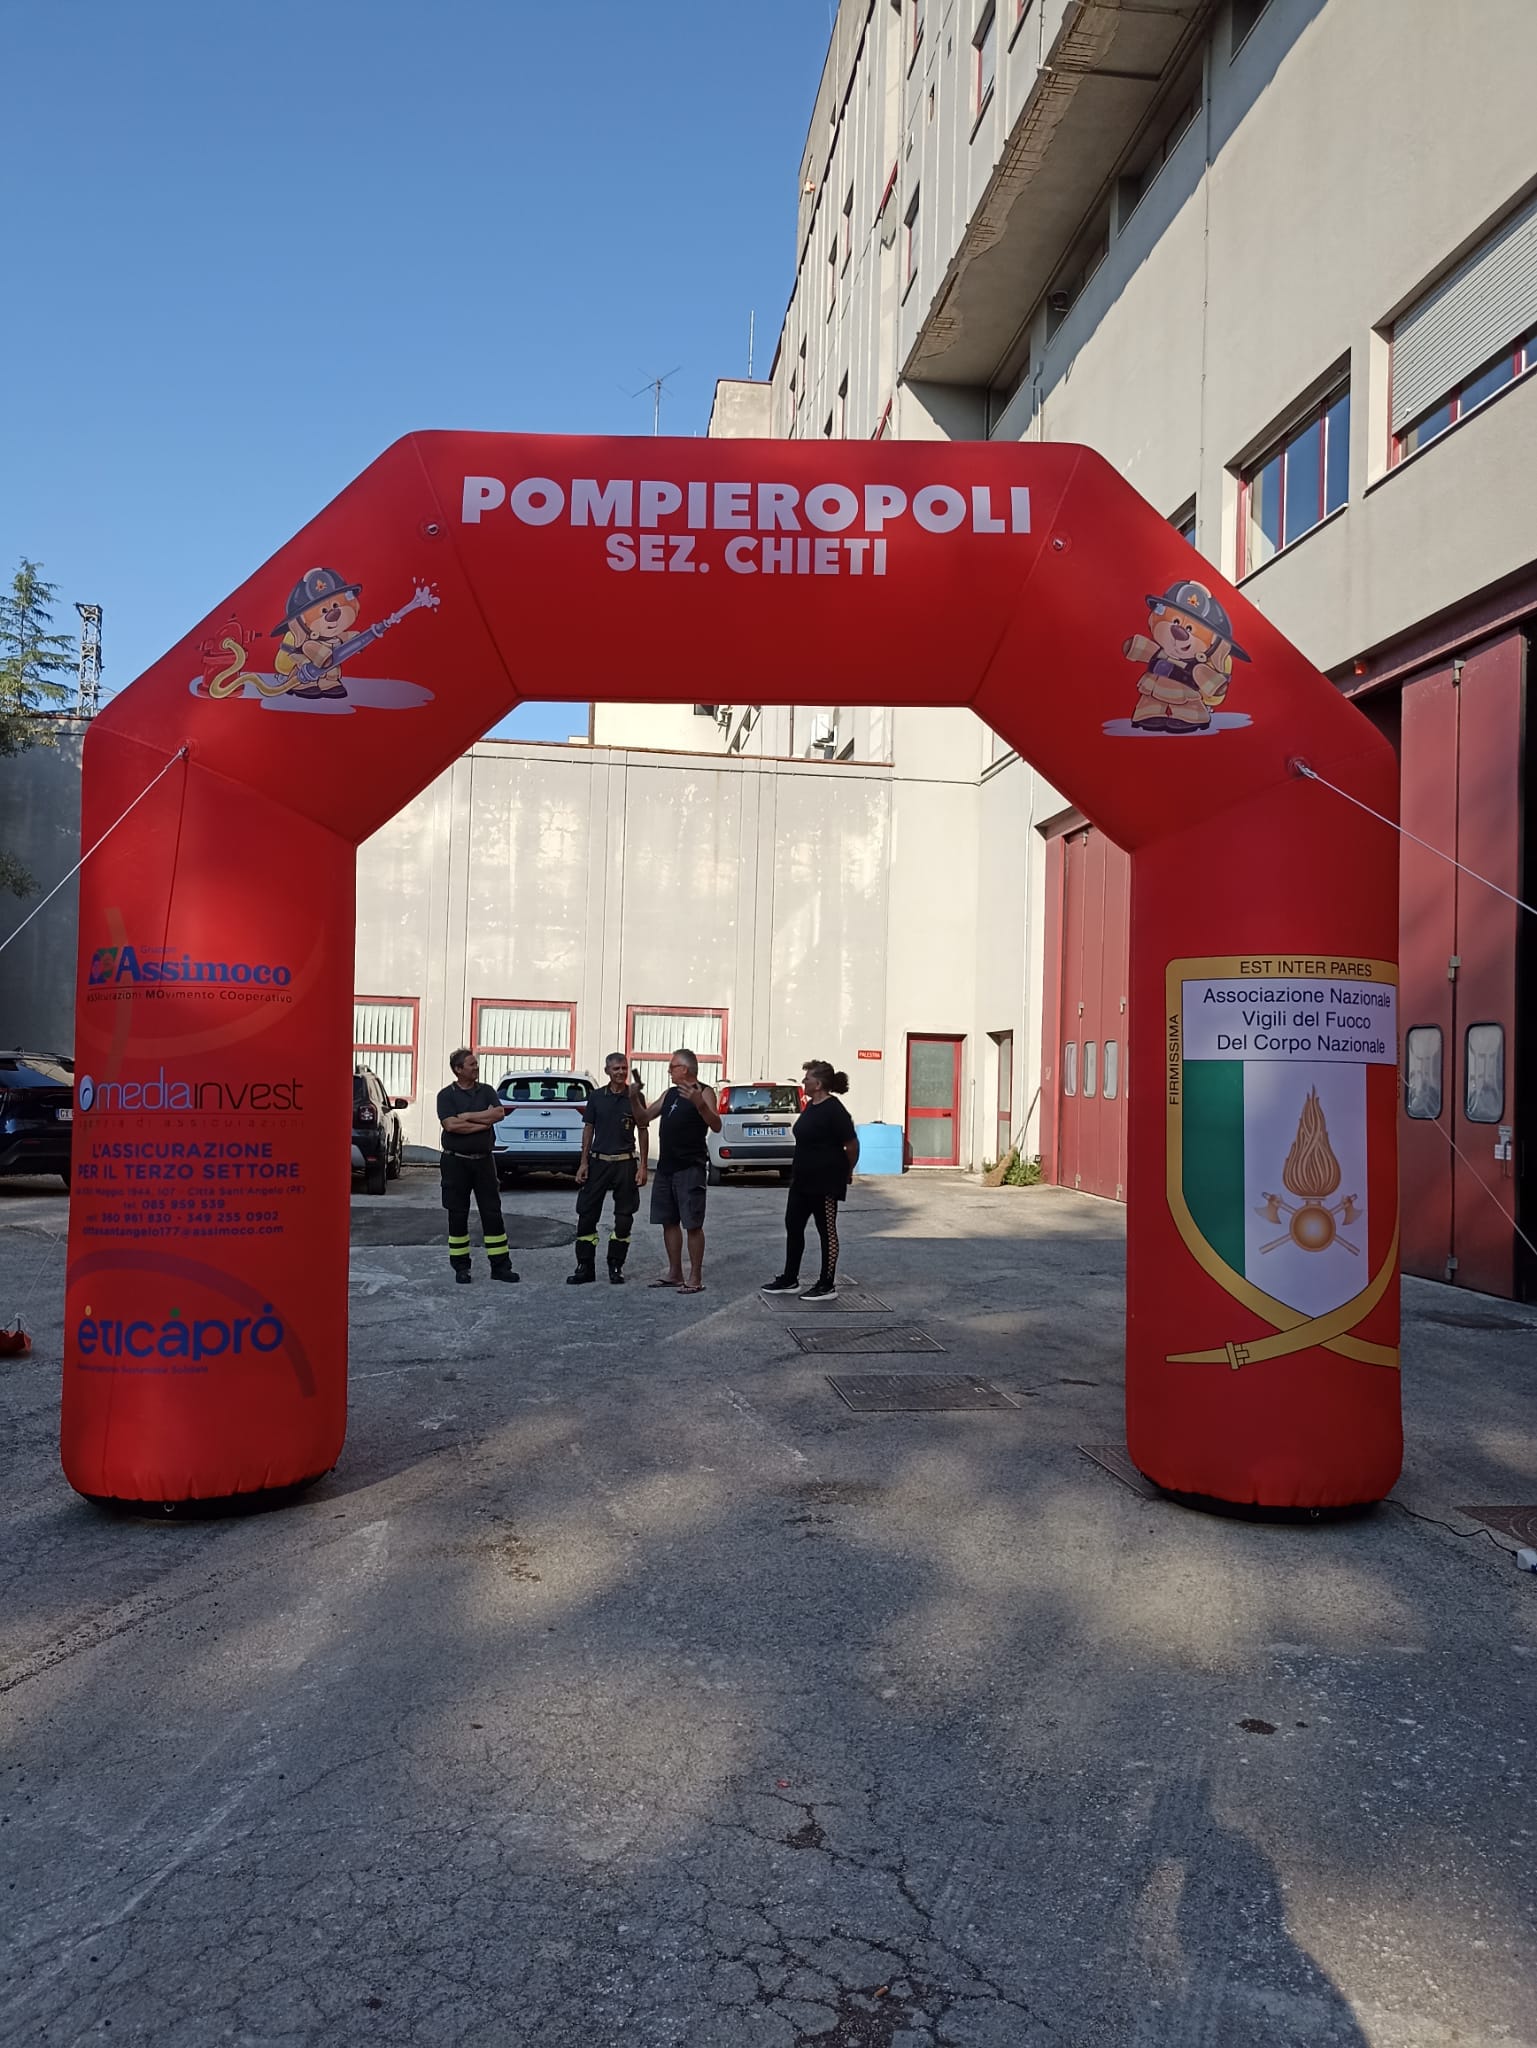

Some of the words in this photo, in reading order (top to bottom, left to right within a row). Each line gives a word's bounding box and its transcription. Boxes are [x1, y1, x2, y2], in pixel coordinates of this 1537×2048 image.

[461, 475, 1031, 534] POMPIEROPOLI
[606, 533, 710, 574] SEZ.
[725, 536, 887, 576] CHIETI
[115, 945, 291, 986] Assimoco
[1240, 961, 1272, 974] EST
[1278, 961, 1326, 974] INTER
[1331, 962, 1372, 977] PARES
[1203, 988, 1324, 1003] Associazione
[1330, 988, 1391, 1008] Nazionale
[1242, 1011, 1287, 1030] Vigili
[1293, 1011, 1320, 1027] del
[1326, 1012, 1371, 1029] Fuoco
[1217, 1034, 1247, 1050] Del
[1254, 1034, 1311, 1054] Corpo
[1317, 1035, 1385, 1054] Nazionale
[1169, 1014, 1179, 1105] FIRMISSIMA
[95, 1066, 304, 1111] mediainvest
[92, 1142, 273, 1159] L'ASSICURAZIONE
[78, 1165, 98, 1180] PER
[103, 1165, 117, 1180] IL
[124, 1164, 194, 1181] TERZO
[203, 1162, 300, 1180] SETTORE
[216, 1212, 241, 1223] 255
[245, 1210, 279, 1222] 0902
